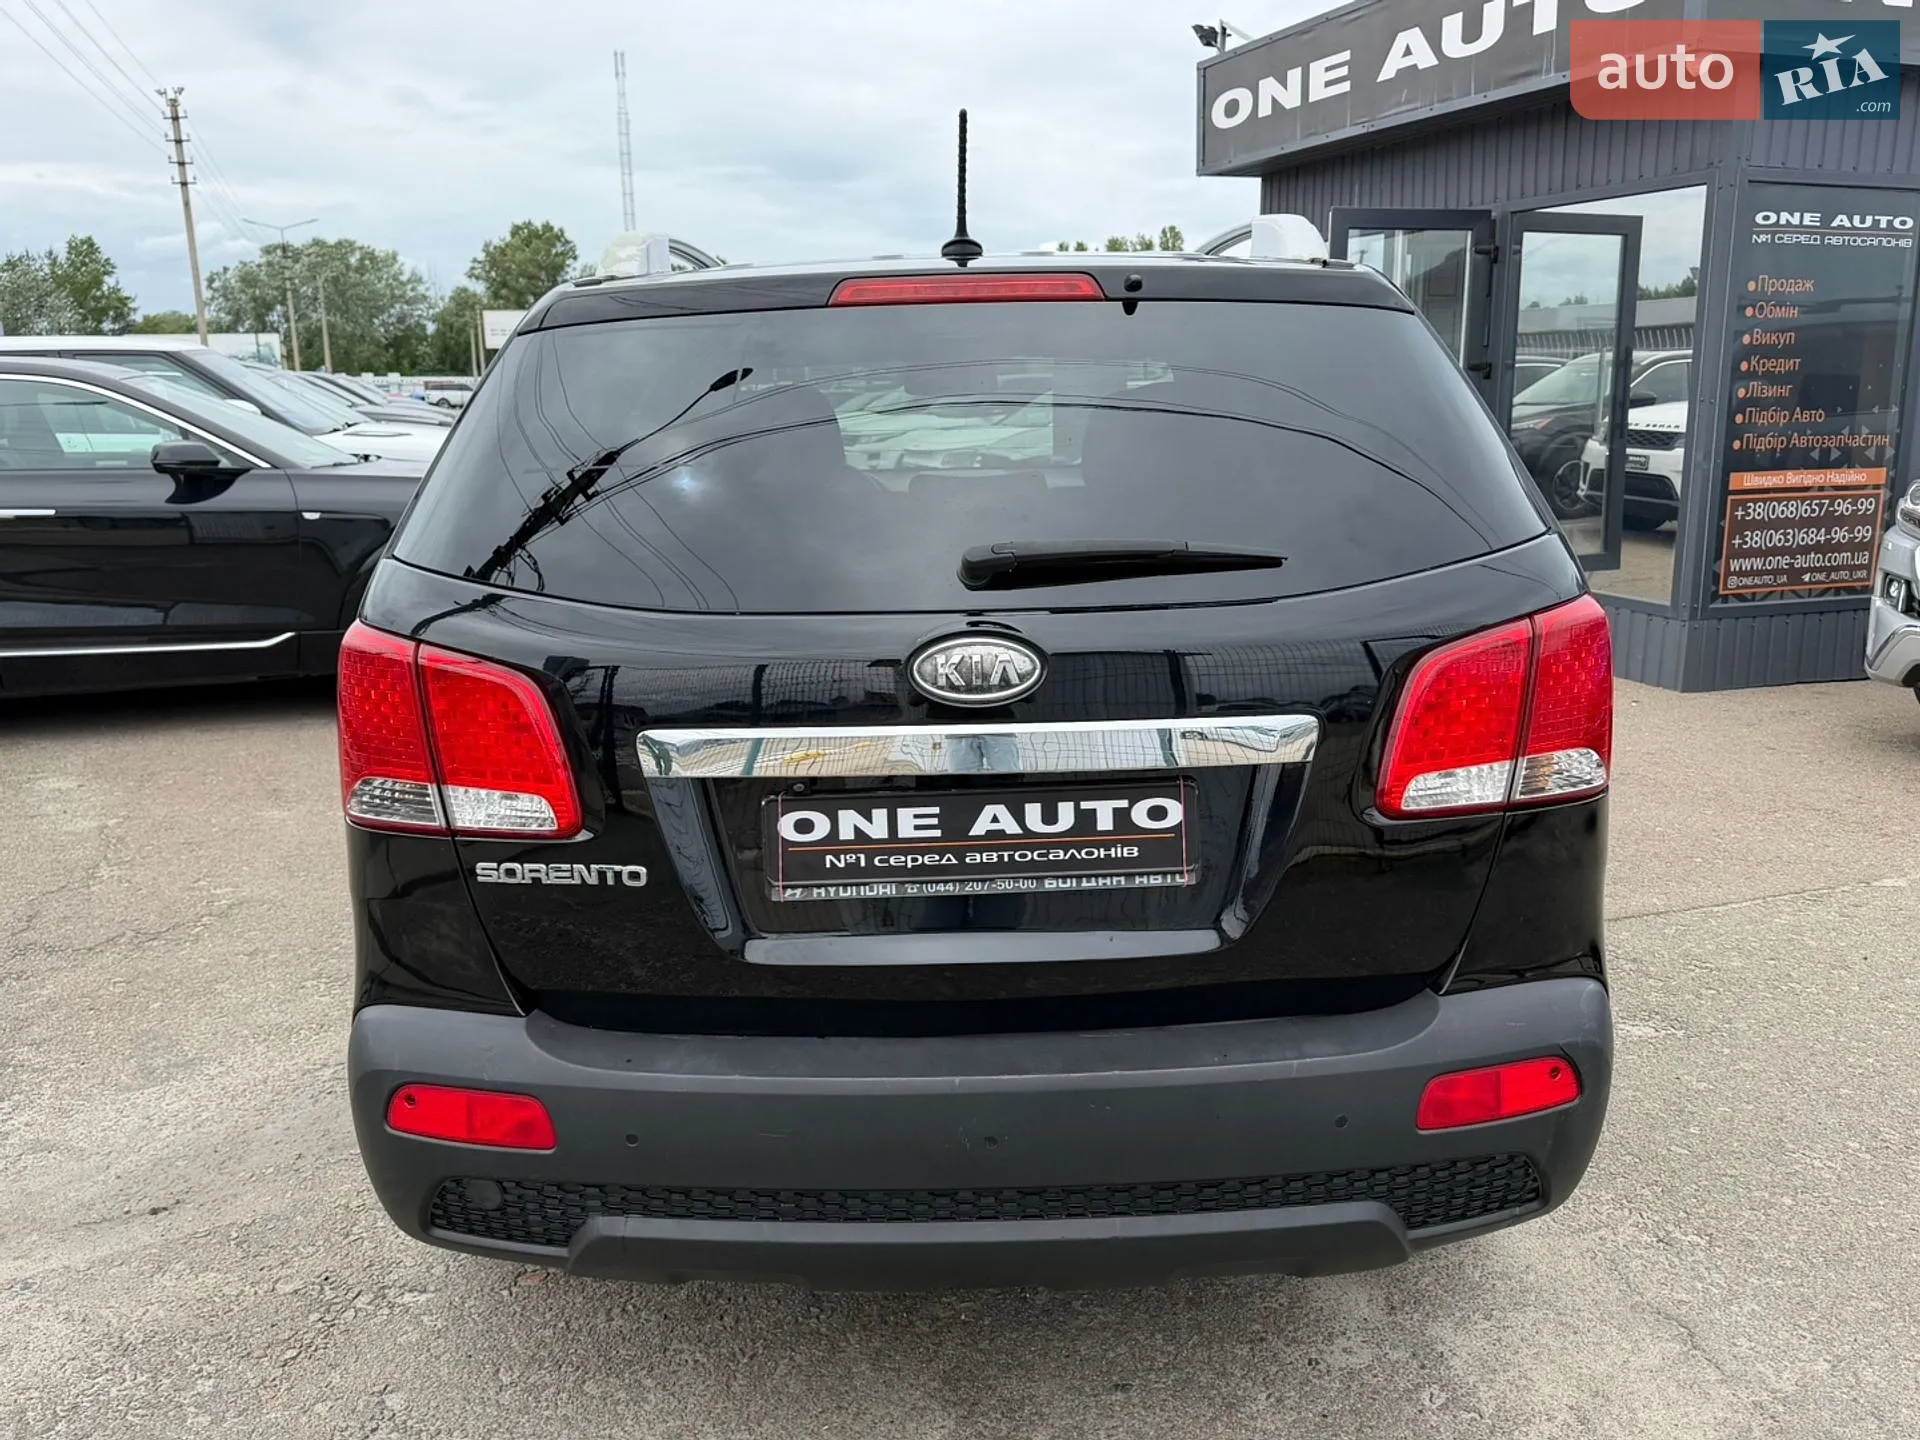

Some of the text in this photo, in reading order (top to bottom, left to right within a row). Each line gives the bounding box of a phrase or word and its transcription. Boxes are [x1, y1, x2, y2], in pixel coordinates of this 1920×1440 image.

[1211, 0, 1655, 130] ONE AUT
[1754, 211, 1914, 229] ONE AUTO
[1774, 234, 1820, 245] СЕРЕД
[1824, 236, 1912, 248] АВТОСАЛОНІВ
[1757, 275, 1815, 295] Продаж
[1755, 301, 1800, 319] Обмін
[1752, 328, 1796, 349] Викуп
[1750, 355, 1801, 376] Кредит
[1747, 382, 1793, 402] Лізинг
[1745, 406, 1825, 427] Підбір Авто
[1742, 433, 1891, 453] Підбір Автозапчастин
[1743, 470, 1868, 488] Швидко Вигідно Надійно
[1734, 498, 1876, 522] +38(068)657-96-99
[1731, 525, 1873, 551] +38(063)684-96-99
[1729, 551, 1870, 573] www.one-auto.com.ua
[935, 653, 1021, 688] KIA
[778, 797, 1185, 842] ONE AUTO
[825, 843, 1139, 869] №1 серед автосалонів
[475, 862, 648, 888] SORENTO
